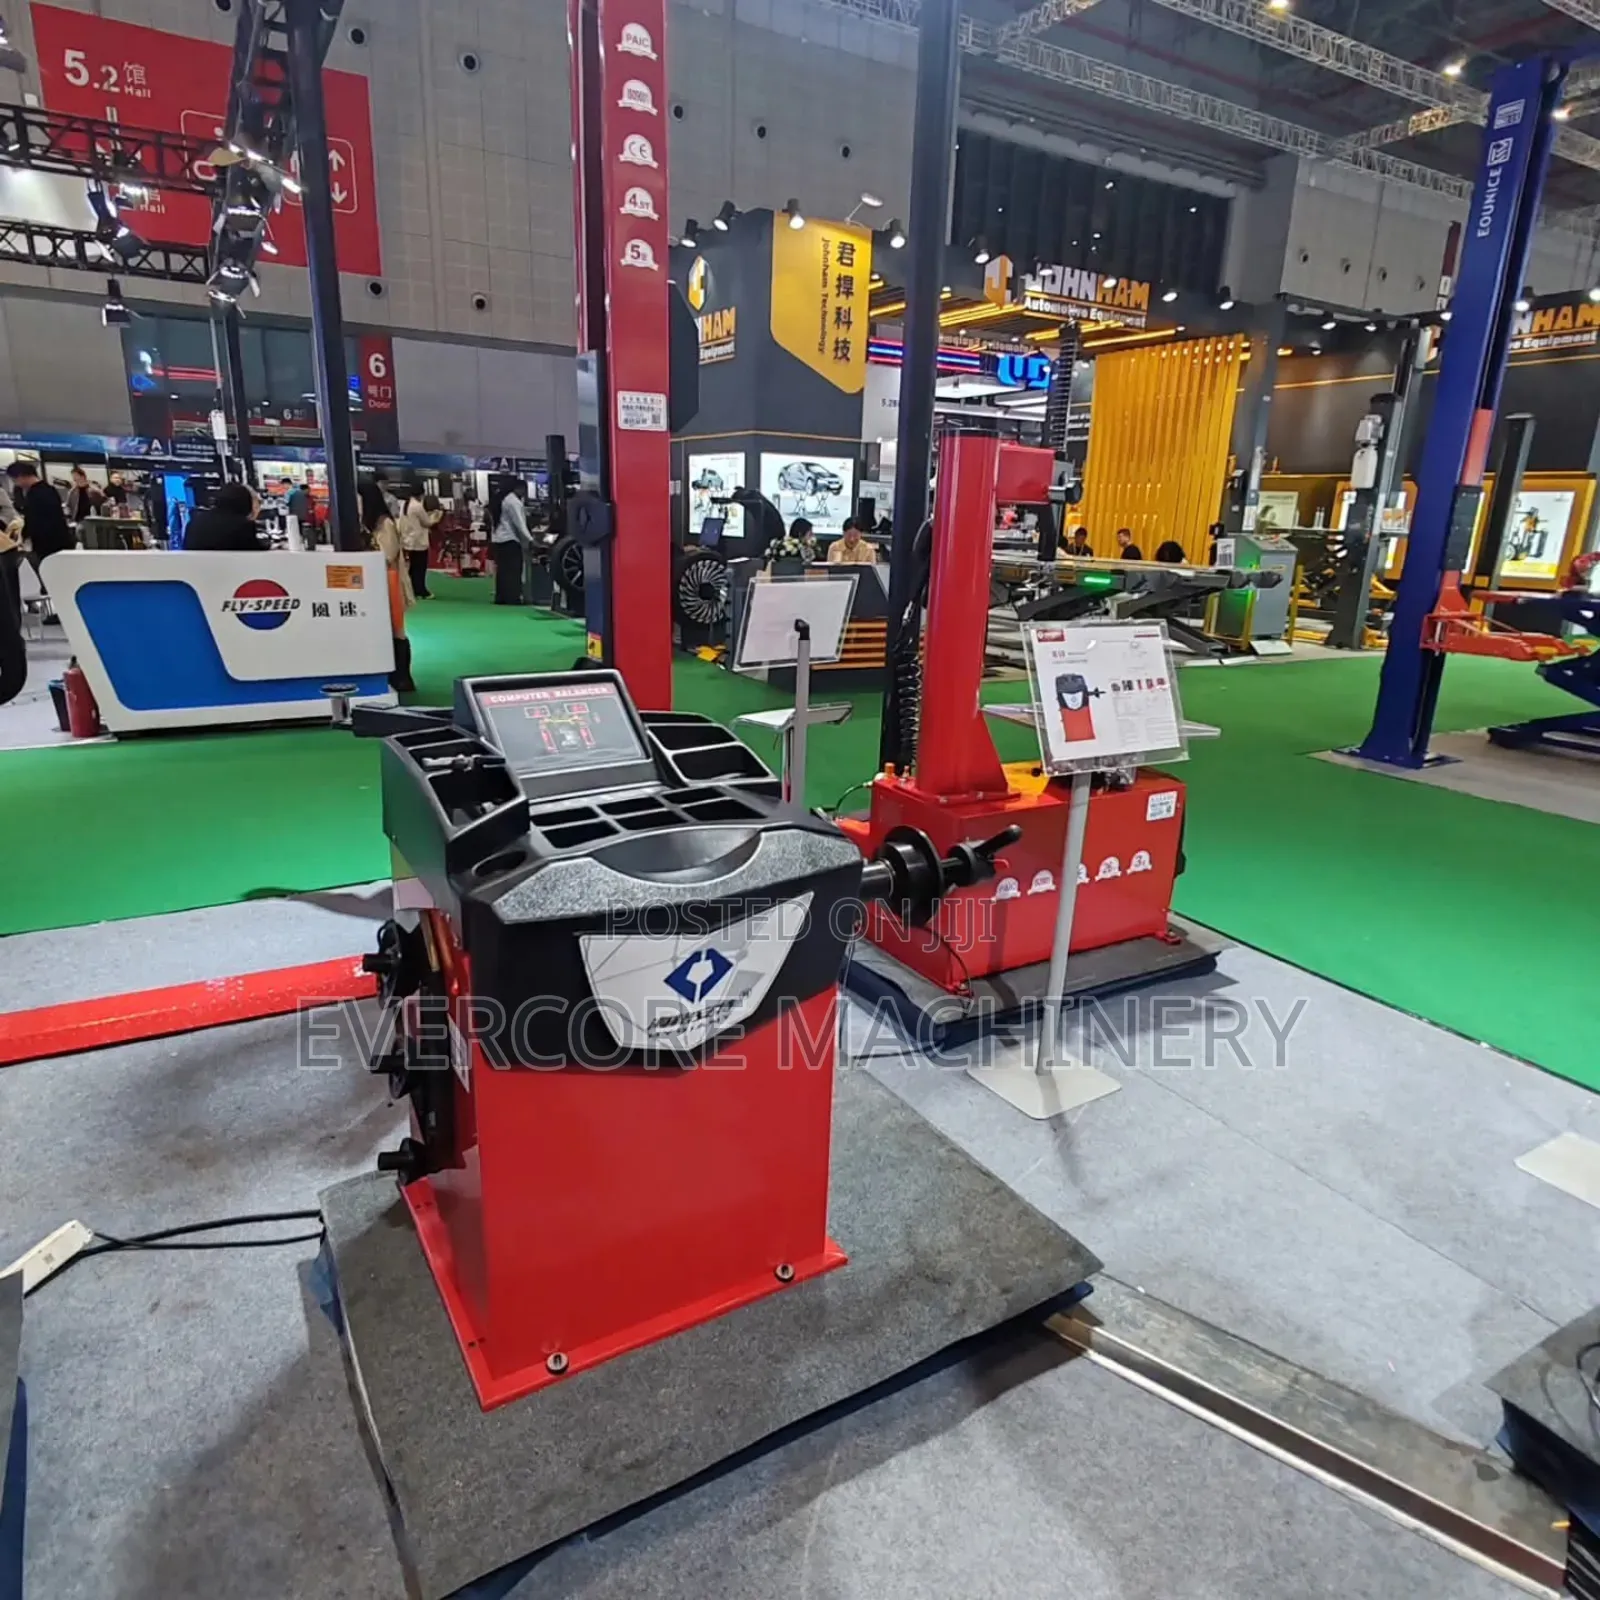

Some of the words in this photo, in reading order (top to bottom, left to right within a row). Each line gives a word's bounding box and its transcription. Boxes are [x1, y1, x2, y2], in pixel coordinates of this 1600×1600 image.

[64, 48, 120, 93] 5.2
[124, 85, 151, 98] Hall
[833, 240, 856, 363] 君捍科技
[368, 352, 387, 379] 6
[221, 598, 301, 613] FLY-SPEED
[489, 689, 550, 704] COMPUTER
